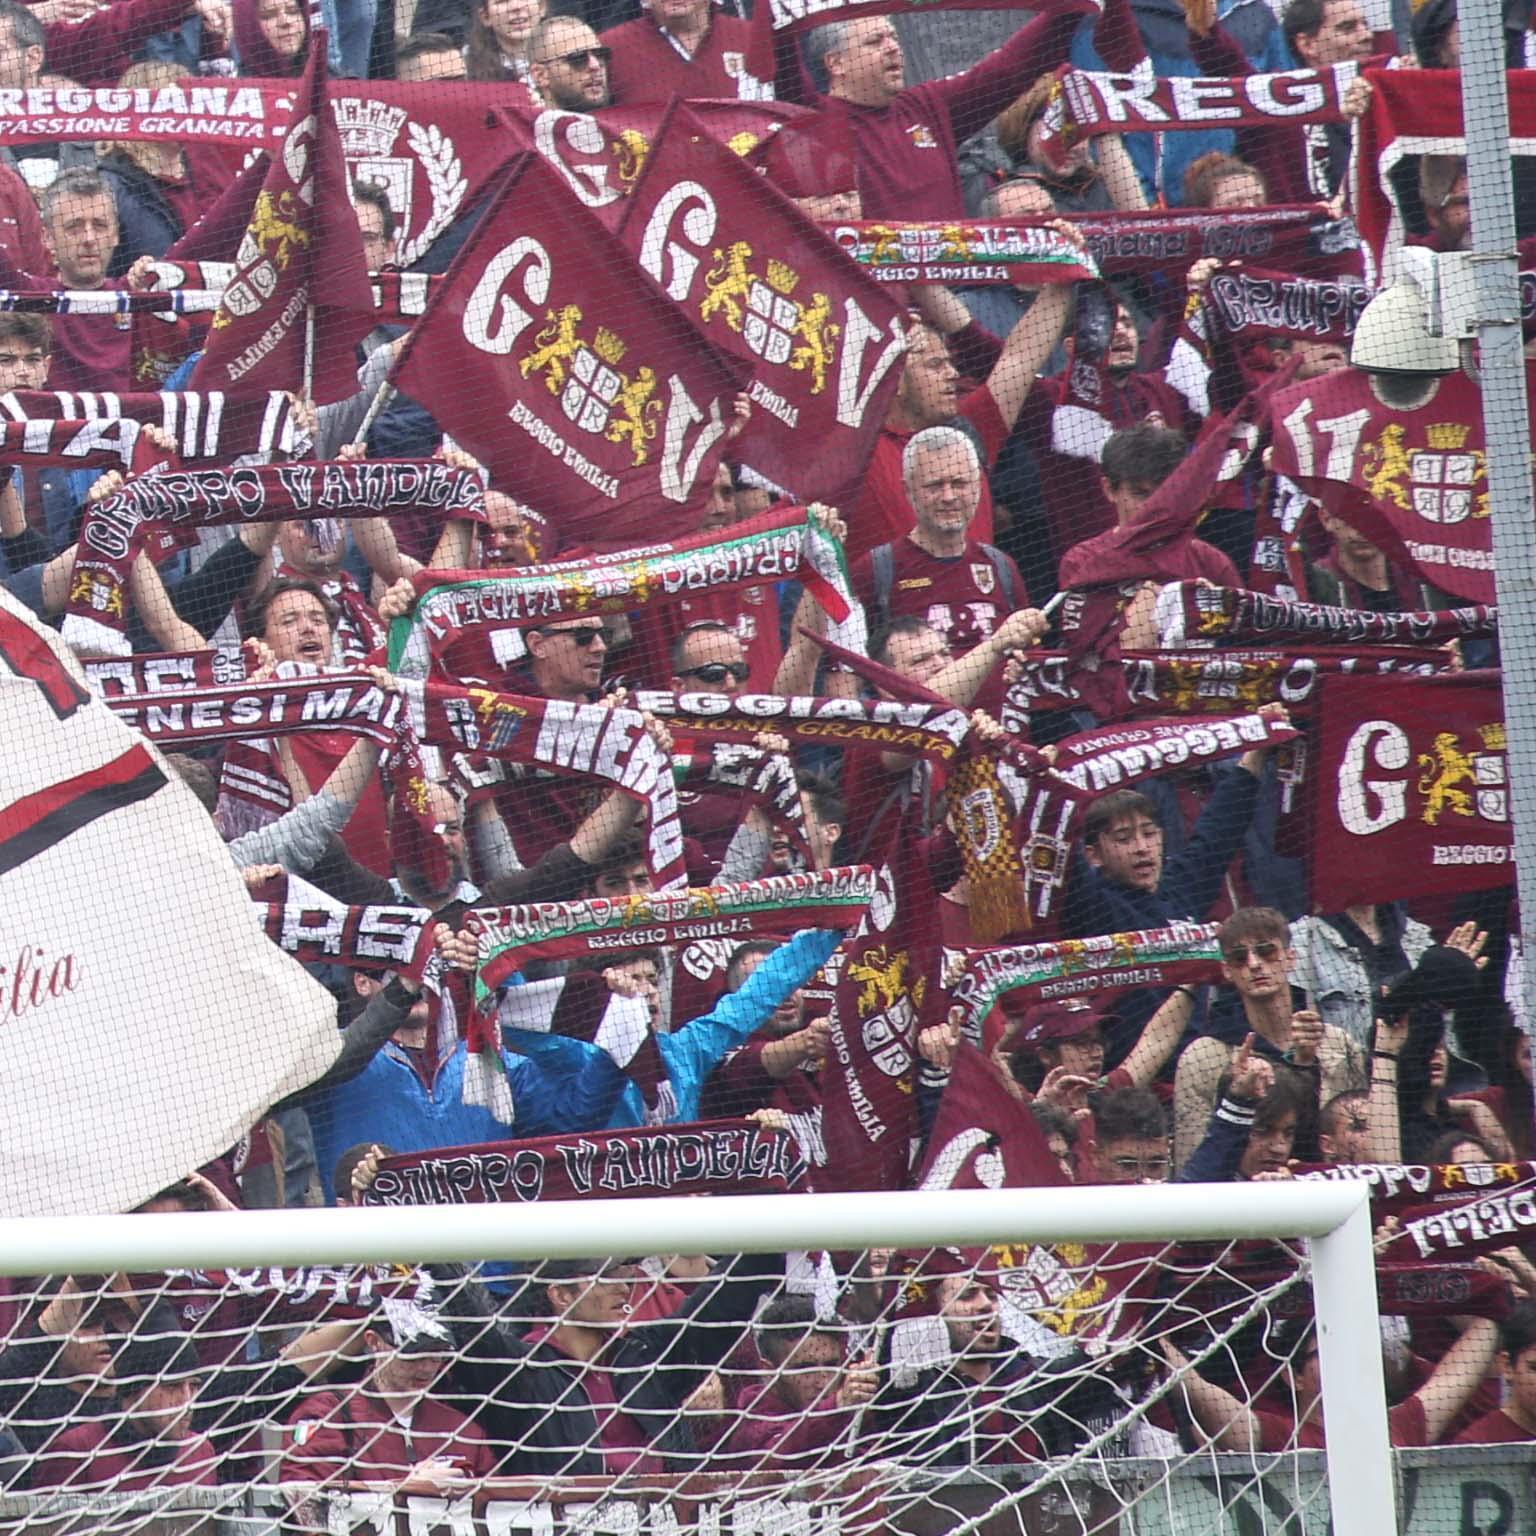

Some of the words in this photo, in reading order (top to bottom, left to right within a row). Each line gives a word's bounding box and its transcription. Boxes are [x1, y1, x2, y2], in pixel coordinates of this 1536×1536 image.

[138, 117, 266, 139] GRANATA
[460, 233, 552, 355] G
[634, 691, 971, 744] EGGIANA
[1337, 719, 1411, 836] G
